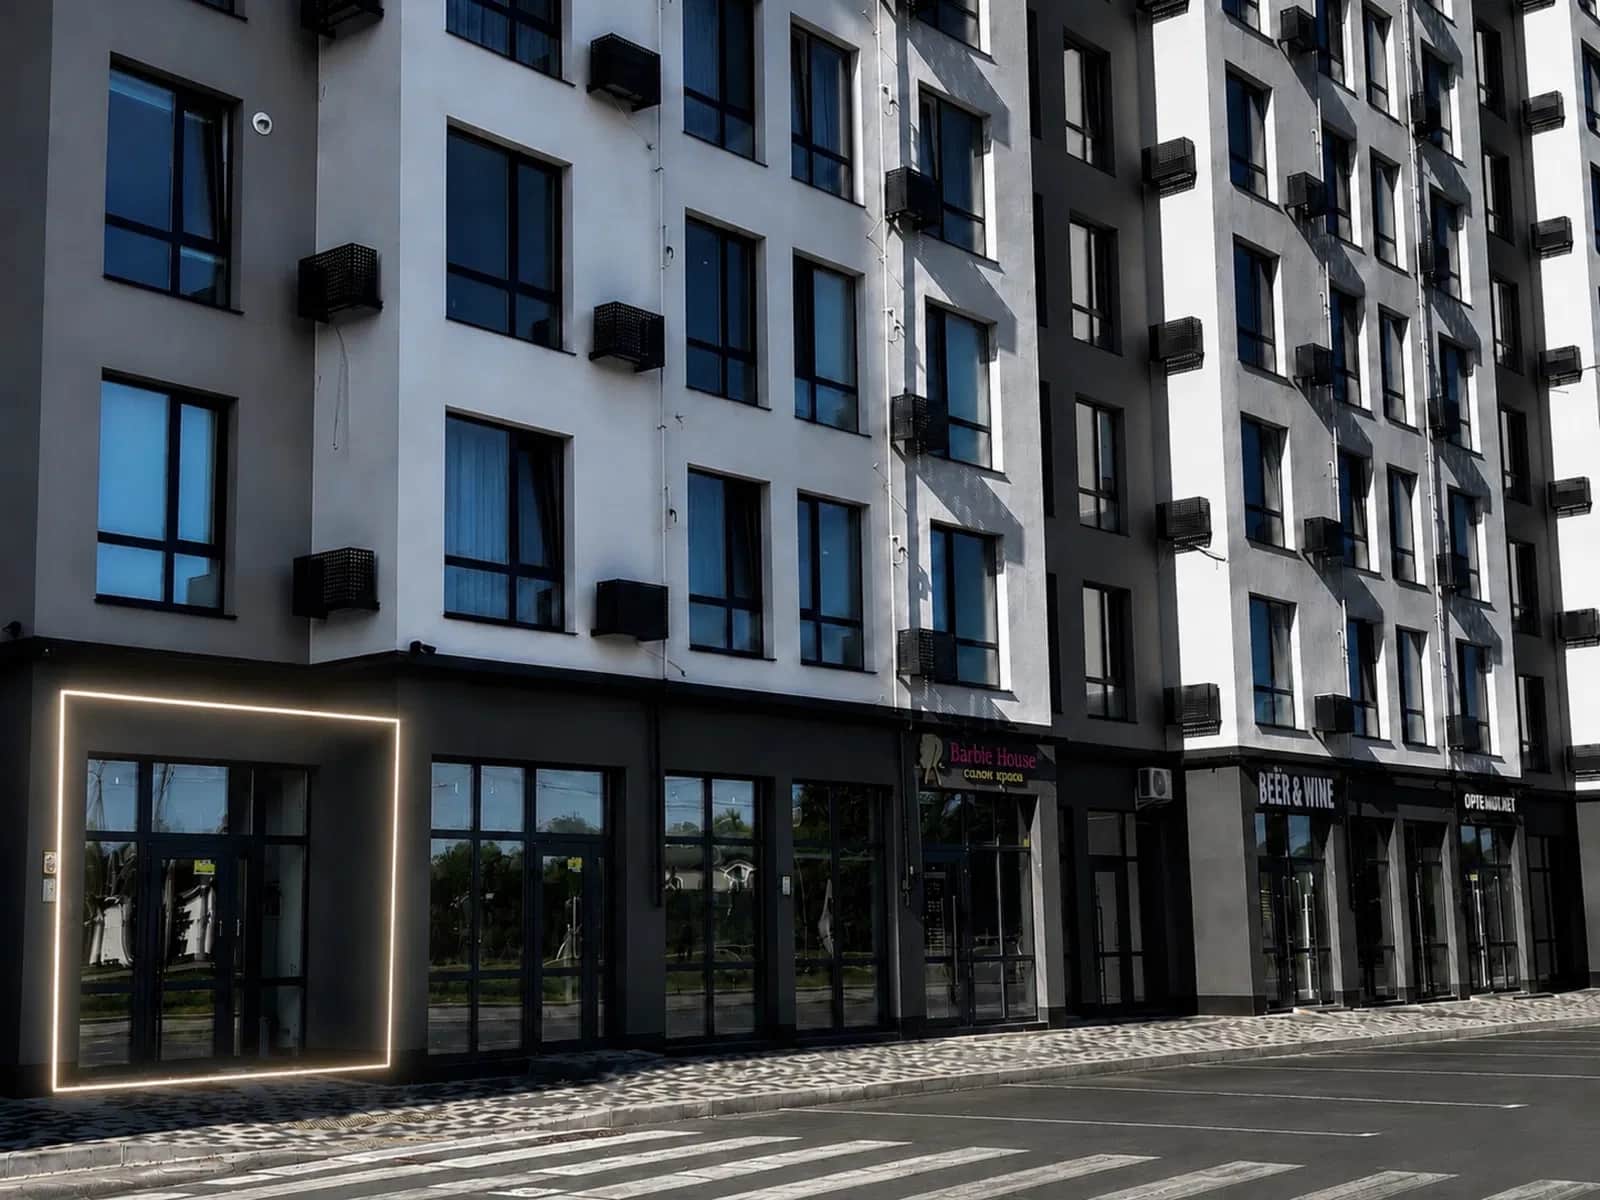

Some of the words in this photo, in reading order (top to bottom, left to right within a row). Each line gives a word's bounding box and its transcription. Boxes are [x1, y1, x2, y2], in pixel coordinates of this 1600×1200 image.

[950, 742, 992, 764] Barbie
[997, 746, 1037, 769] House
[963, 767, 994, 779] салон
[1292, 776, 1303, 806] &
[1302, 775, 1335, 808] WINE
